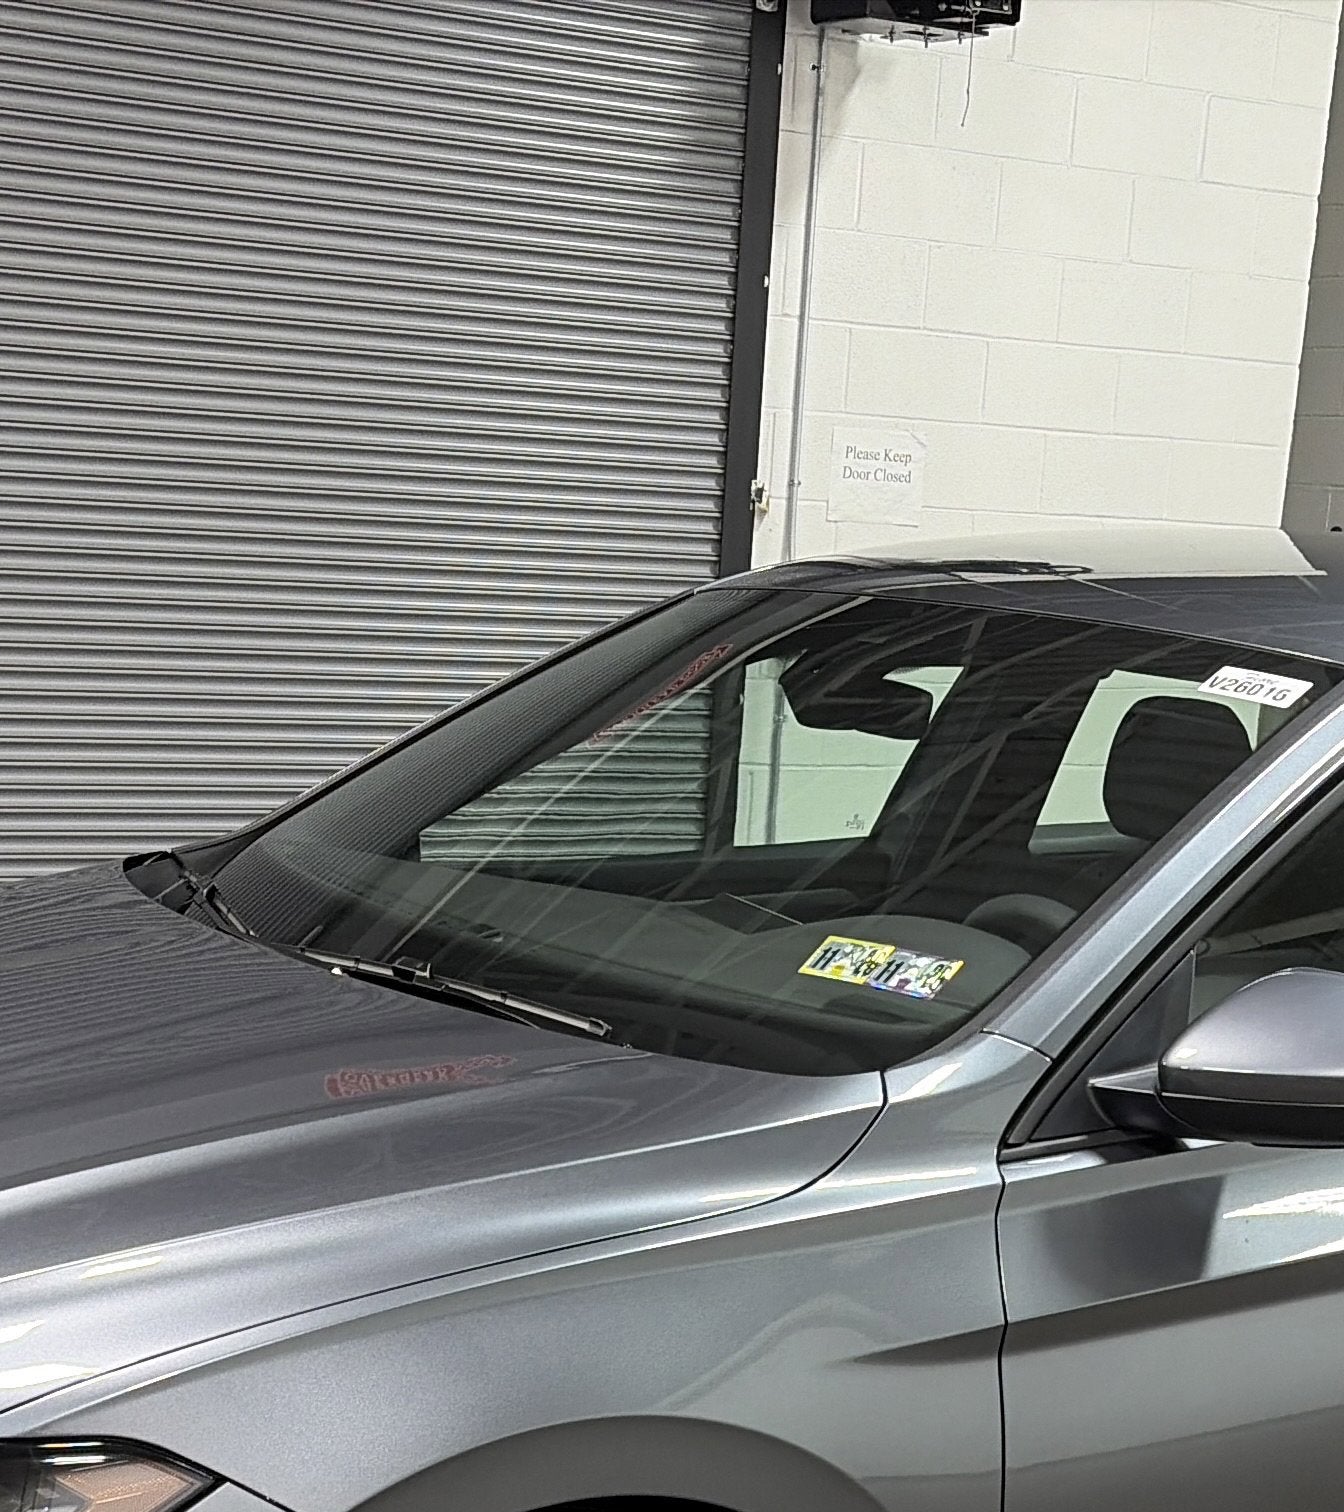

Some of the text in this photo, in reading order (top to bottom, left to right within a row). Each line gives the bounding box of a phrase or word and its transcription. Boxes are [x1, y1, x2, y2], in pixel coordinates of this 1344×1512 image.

[845, 445, 912, 466] Please Keep
[842, 465, 912, 484] Door Closed
[1208, 675, 1292, 702] V26016
